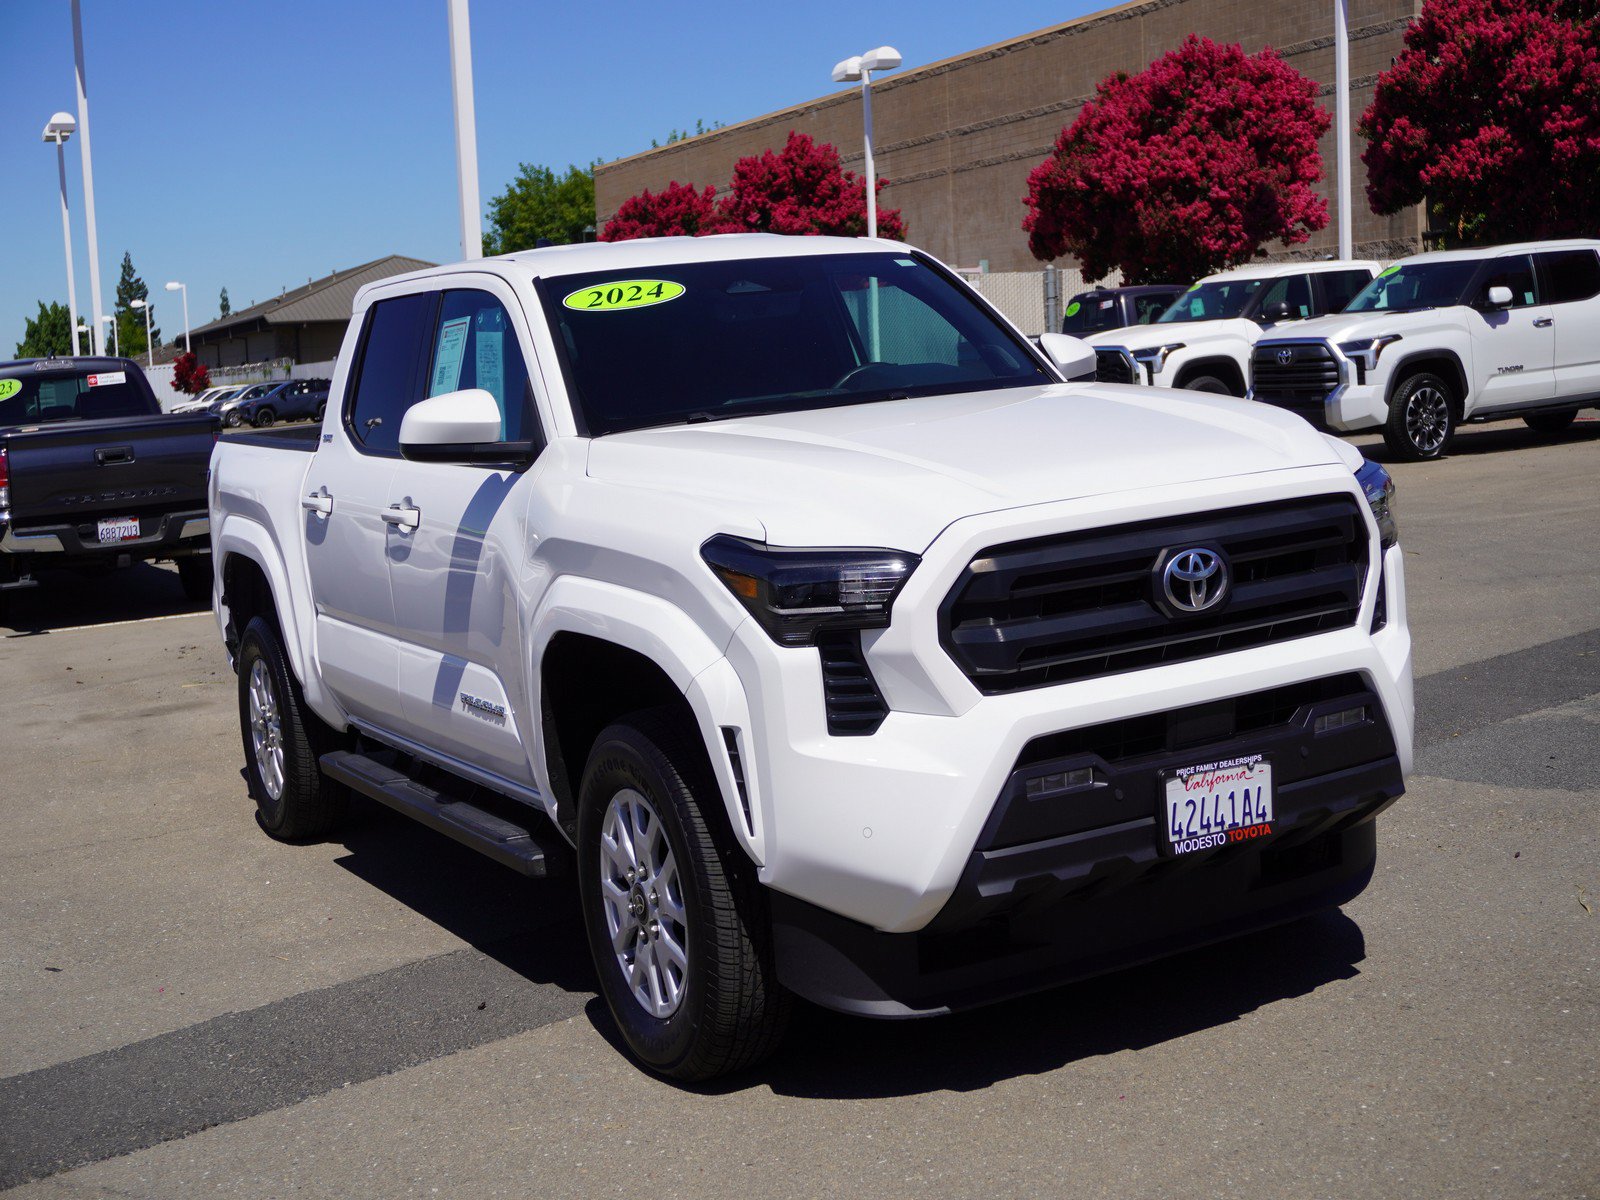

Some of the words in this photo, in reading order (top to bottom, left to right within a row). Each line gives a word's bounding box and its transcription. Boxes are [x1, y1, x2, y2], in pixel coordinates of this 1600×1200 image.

[587, 282, 664, 308] 2024
[1176, 766, 1195, 777] PRICE
[1196, 762, 1219, 774] FAMILY
[1219, 754, 1262, 768] DEALERSHIPS
[1185, 770, 1254, 793] California
[1171, 786, 1267, 839] 42441A4
[1174, 833, 1226, 855] MODESTO
[1228, 823, 1272, 842] TOYOTA
